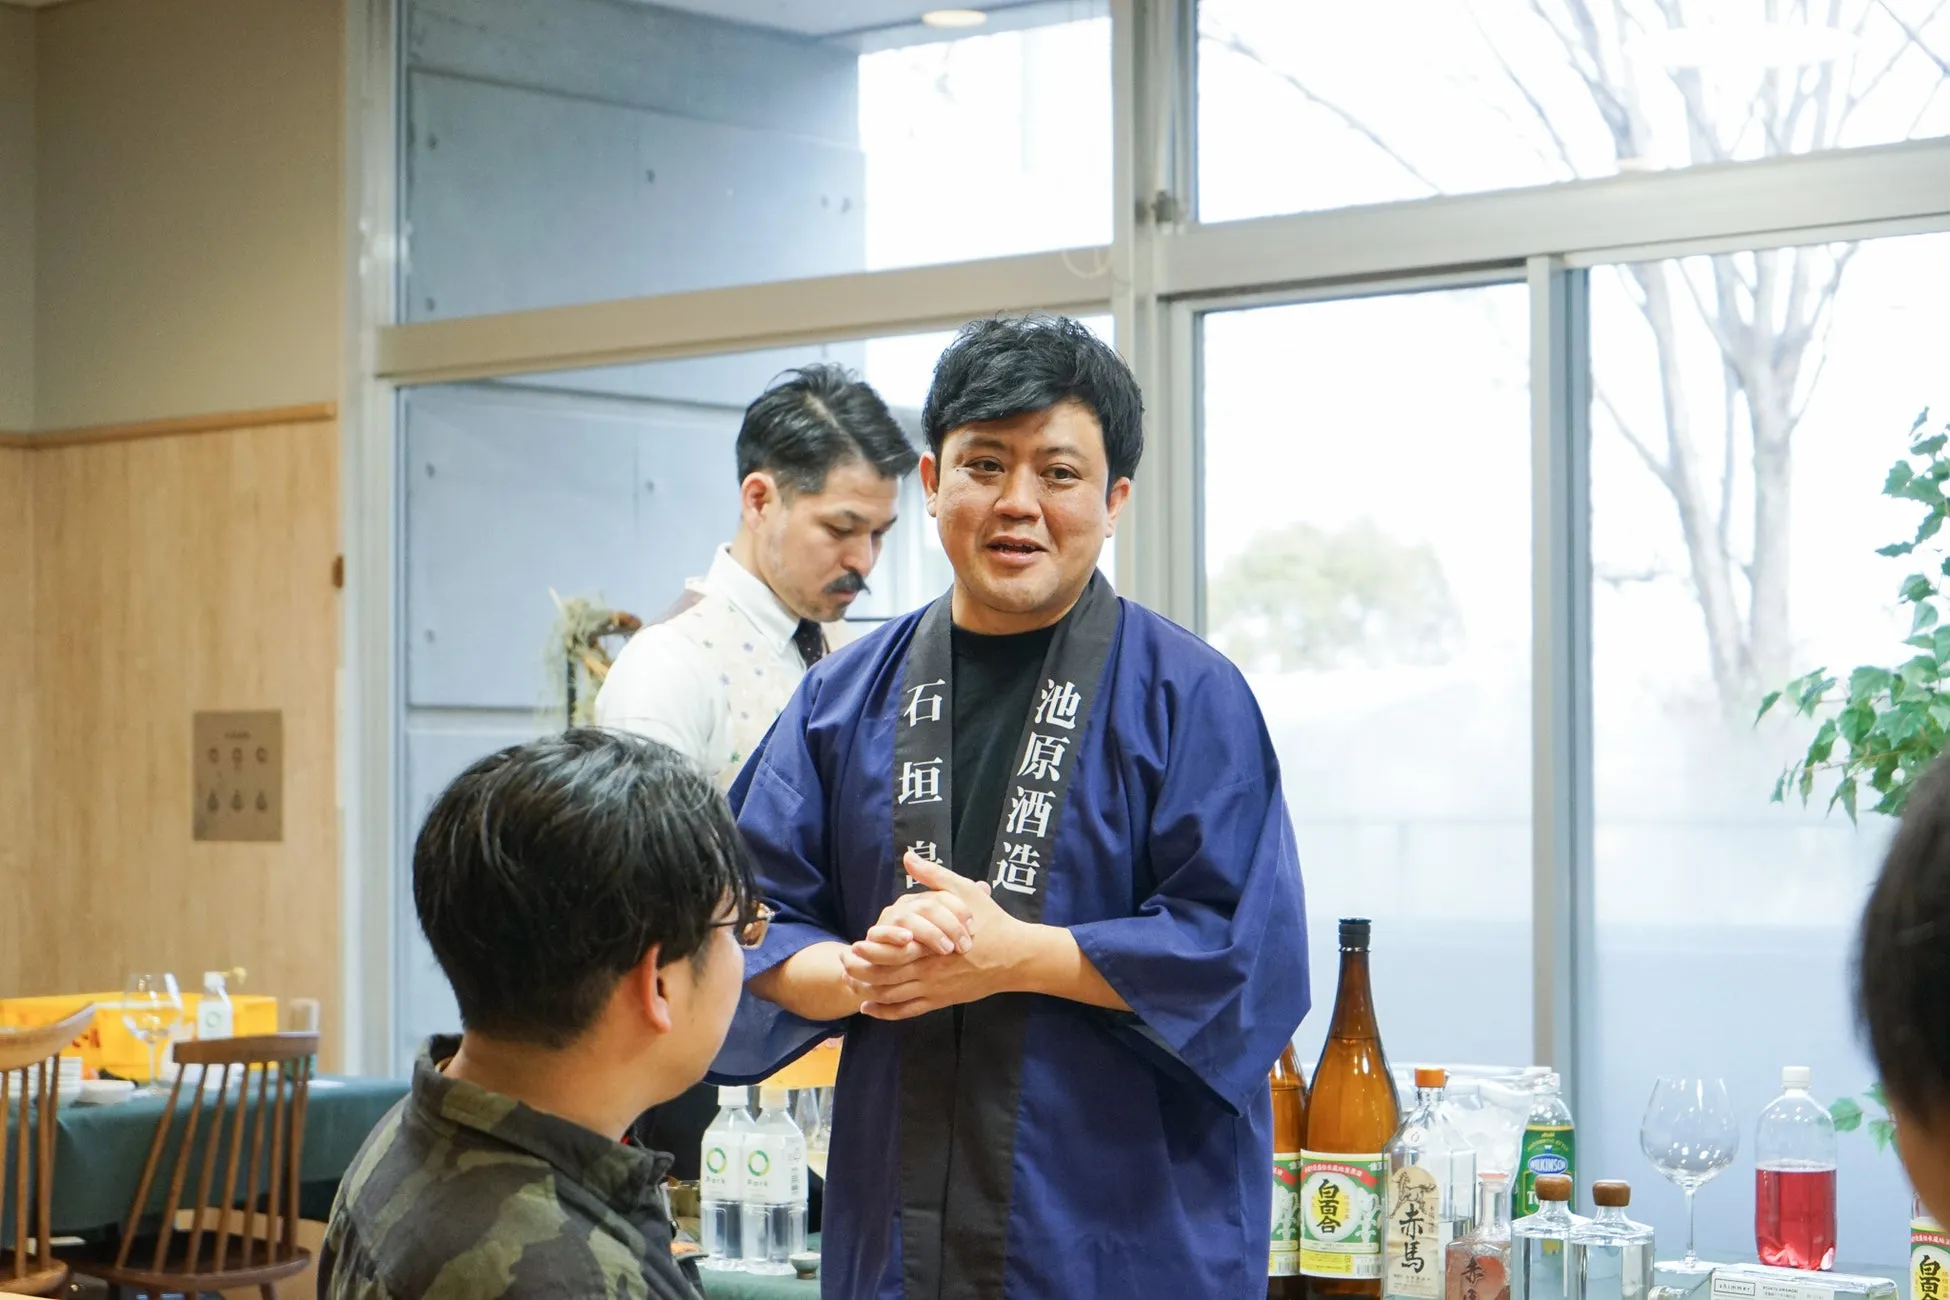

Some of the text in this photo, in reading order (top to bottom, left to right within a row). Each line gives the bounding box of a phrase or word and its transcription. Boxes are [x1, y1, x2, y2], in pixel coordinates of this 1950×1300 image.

[992, 679, 1082, 895] 池原酒造
[1316, 1178, 1342, 1234] 白百合
[1399, 1203, 1425, 1273] 赤馬
